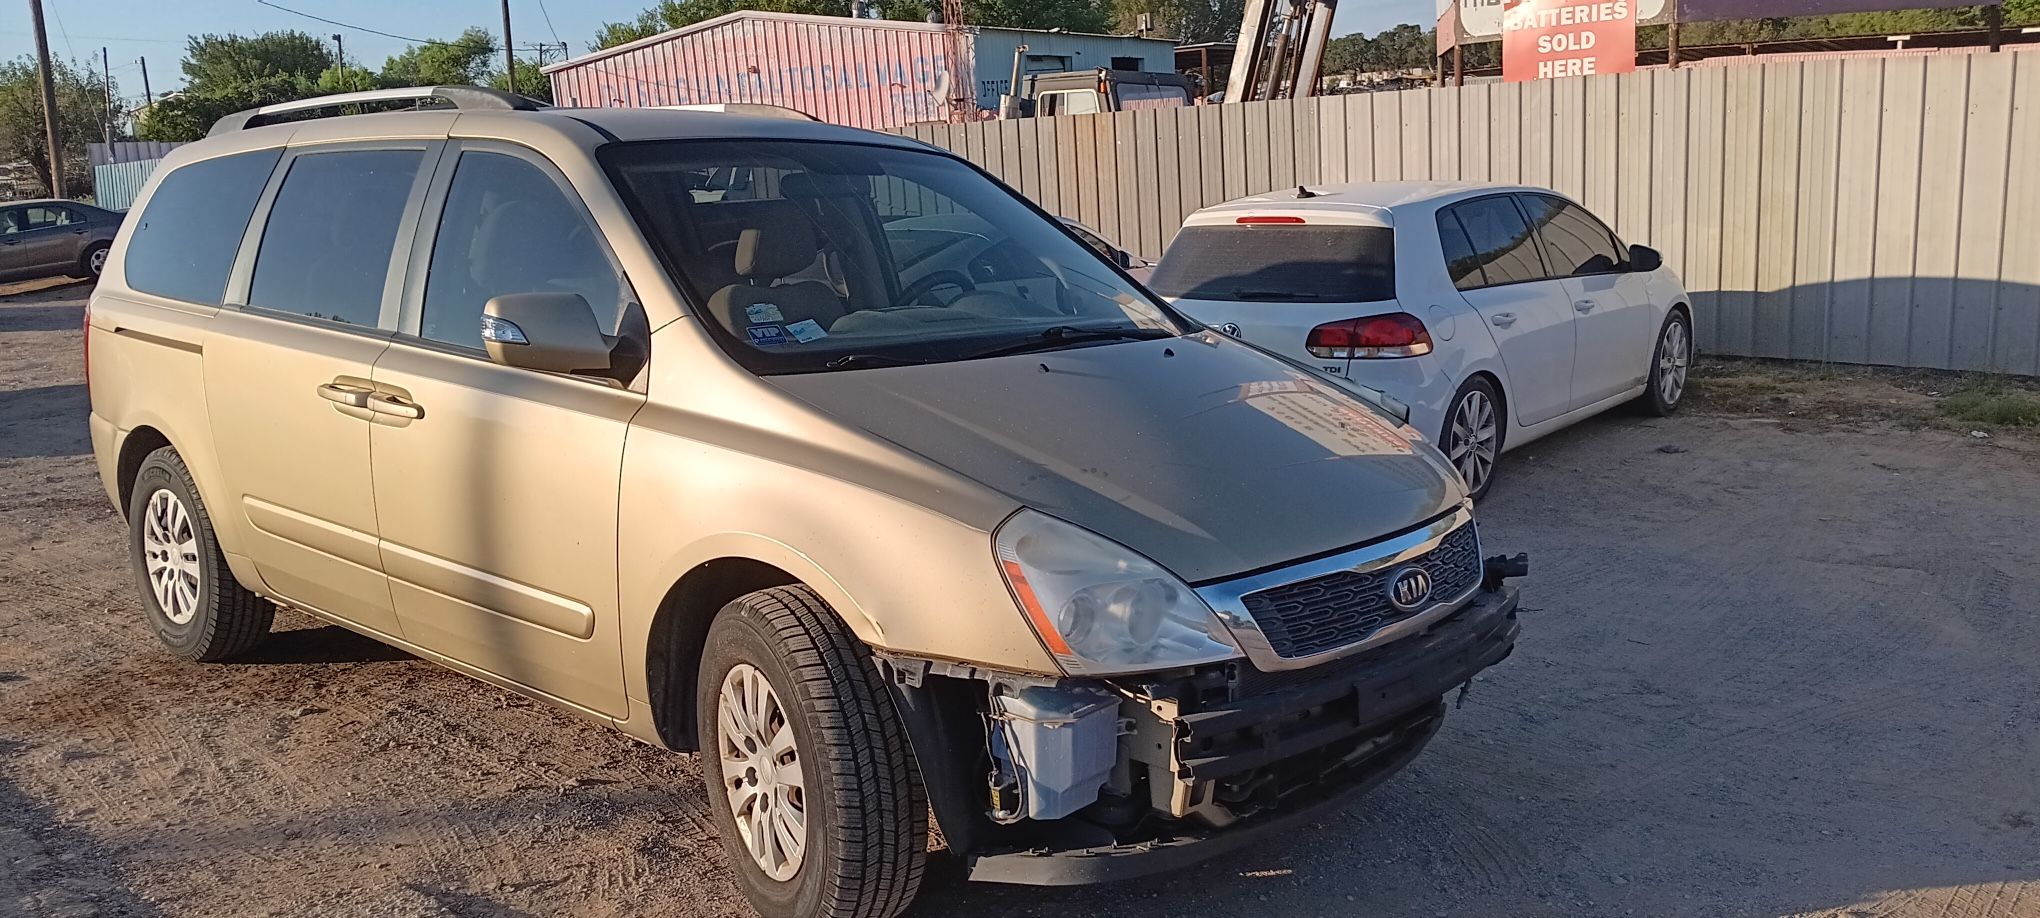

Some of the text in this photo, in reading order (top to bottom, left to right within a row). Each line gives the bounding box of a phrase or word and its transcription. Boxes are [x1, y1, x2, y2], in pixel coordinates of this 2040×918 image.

[1509, 2, 1629, 31] BATTERIES
[1537, 31, 1596, 54] SOLD
[1537, 57, 1597, 79] HERE
[749, 327, 780, 338] VIP
[1322, 366, 1342, 374] TDI
[1397, 574, 1428, 604] KIA
